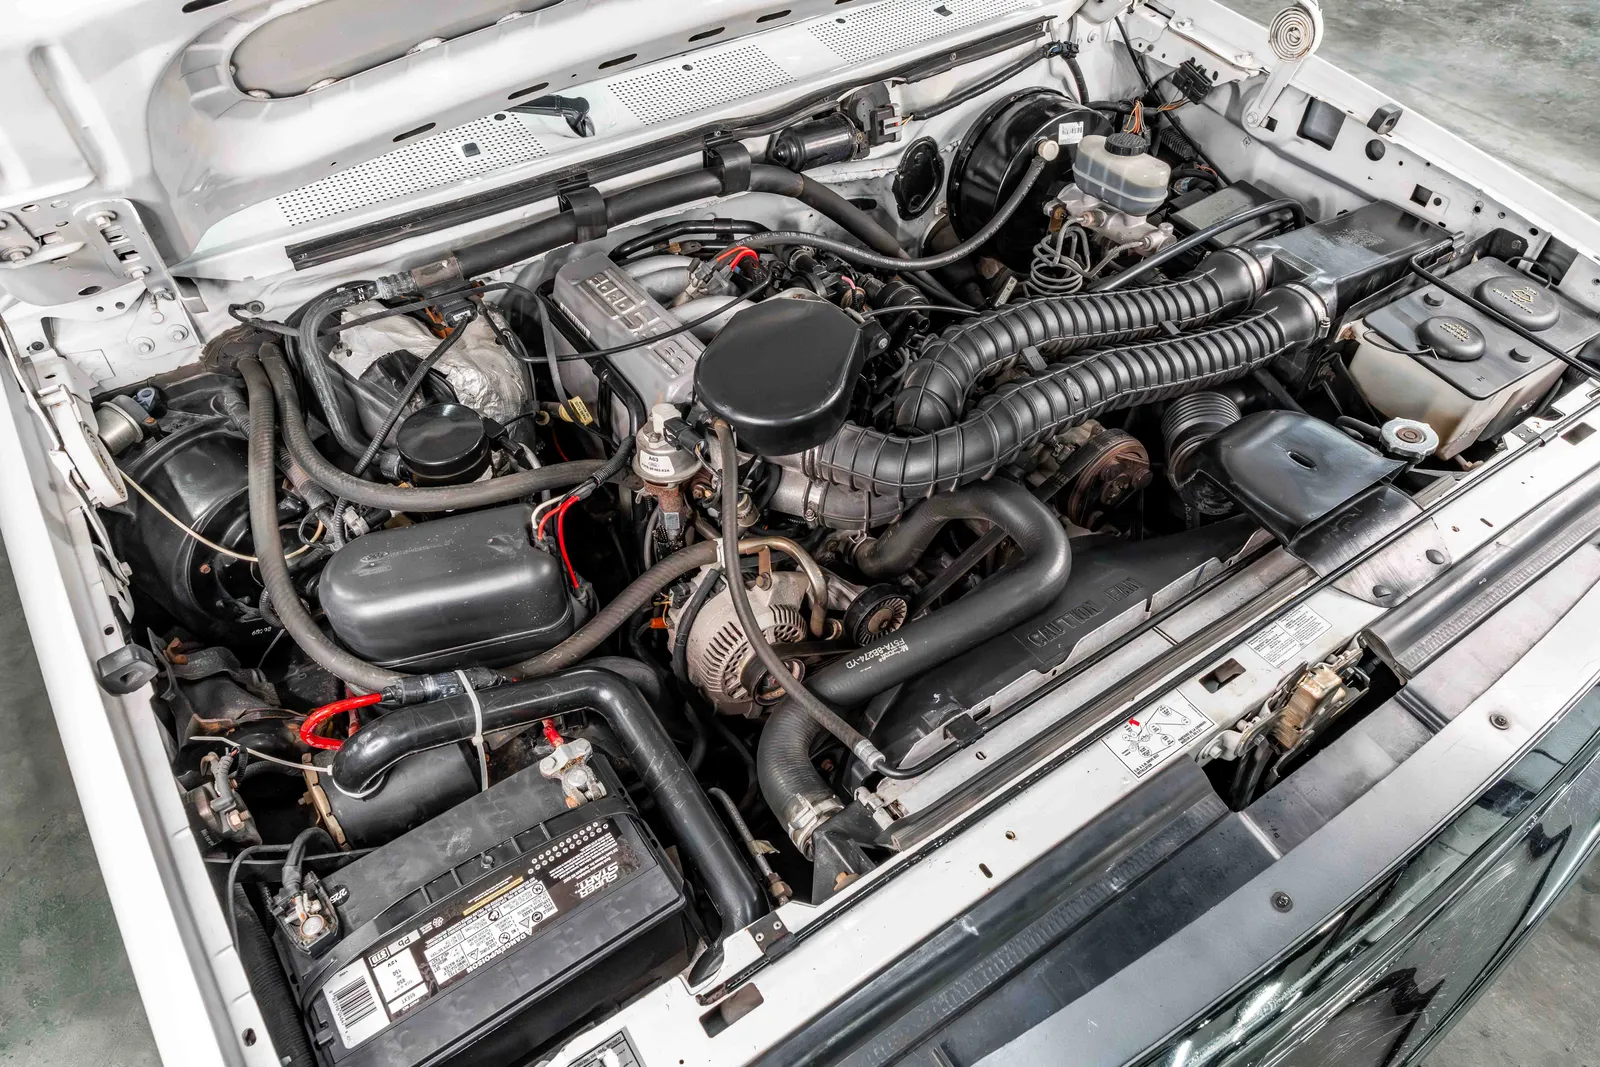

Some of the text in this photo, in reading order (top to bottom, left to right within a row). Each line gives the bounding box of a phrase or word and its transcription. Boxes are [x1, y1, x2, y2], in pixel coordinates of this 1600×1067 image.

[1026, 575, 1144, 648] CAUTION FAN
[844, 637, 905, 669] F5TA-8B274-YD
[328, 887, 348, 903] 2/25
[577, 870, 617, 898] SUPER
[397, 936, 410, 948] Pb
[465, 931, 527, 973] DANGER/POISON
